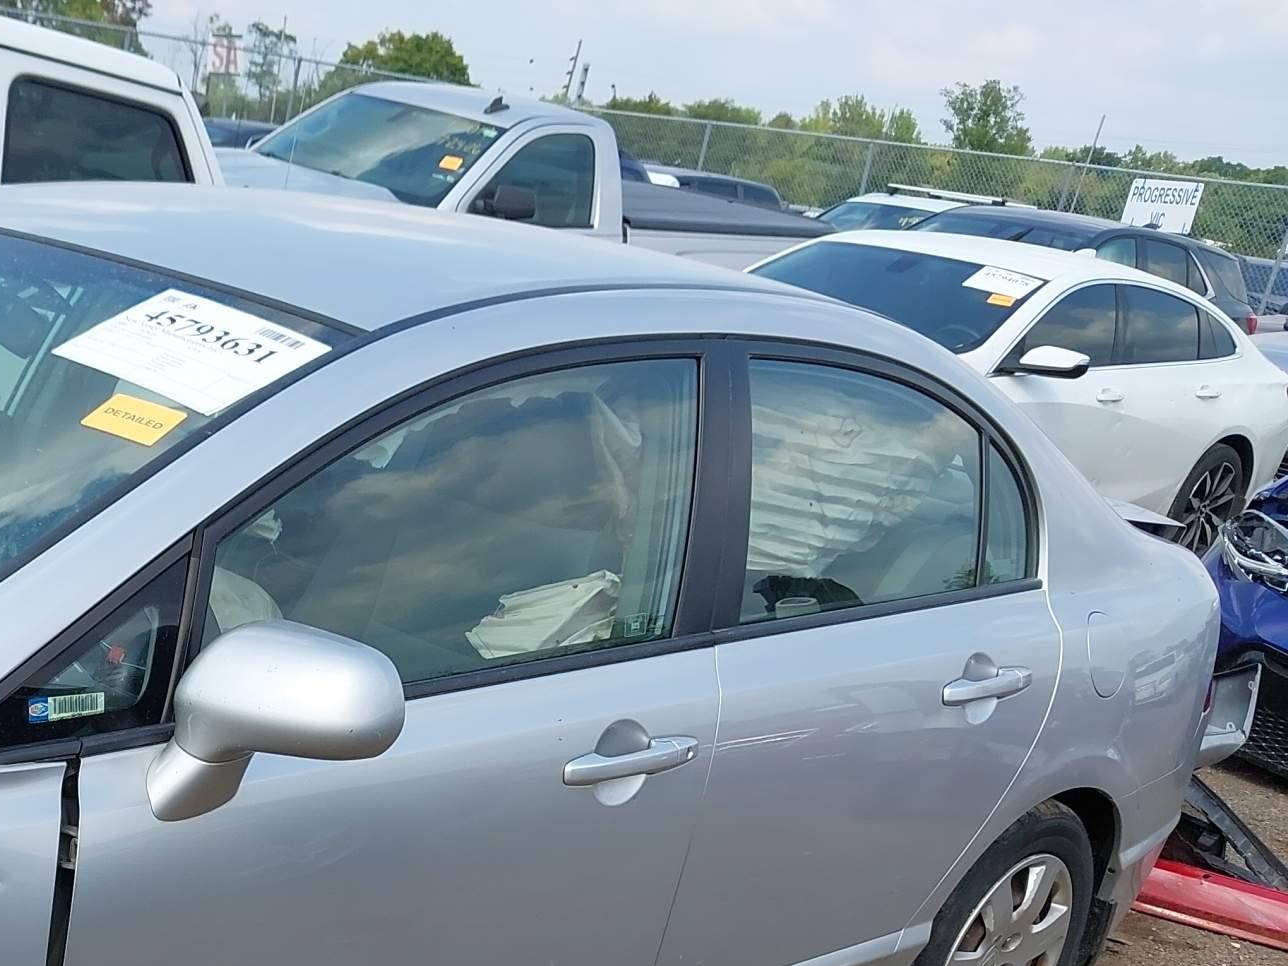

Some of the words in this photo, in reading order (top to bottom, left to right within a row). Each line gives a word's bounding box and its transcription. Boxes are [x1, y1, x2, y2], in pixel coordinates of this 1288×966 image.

[1130, 185, 1200, 206] PROGRESSIVE
[145, 309, 280, 364] 45793631
[103, 406, 165, 431] DETAILED
